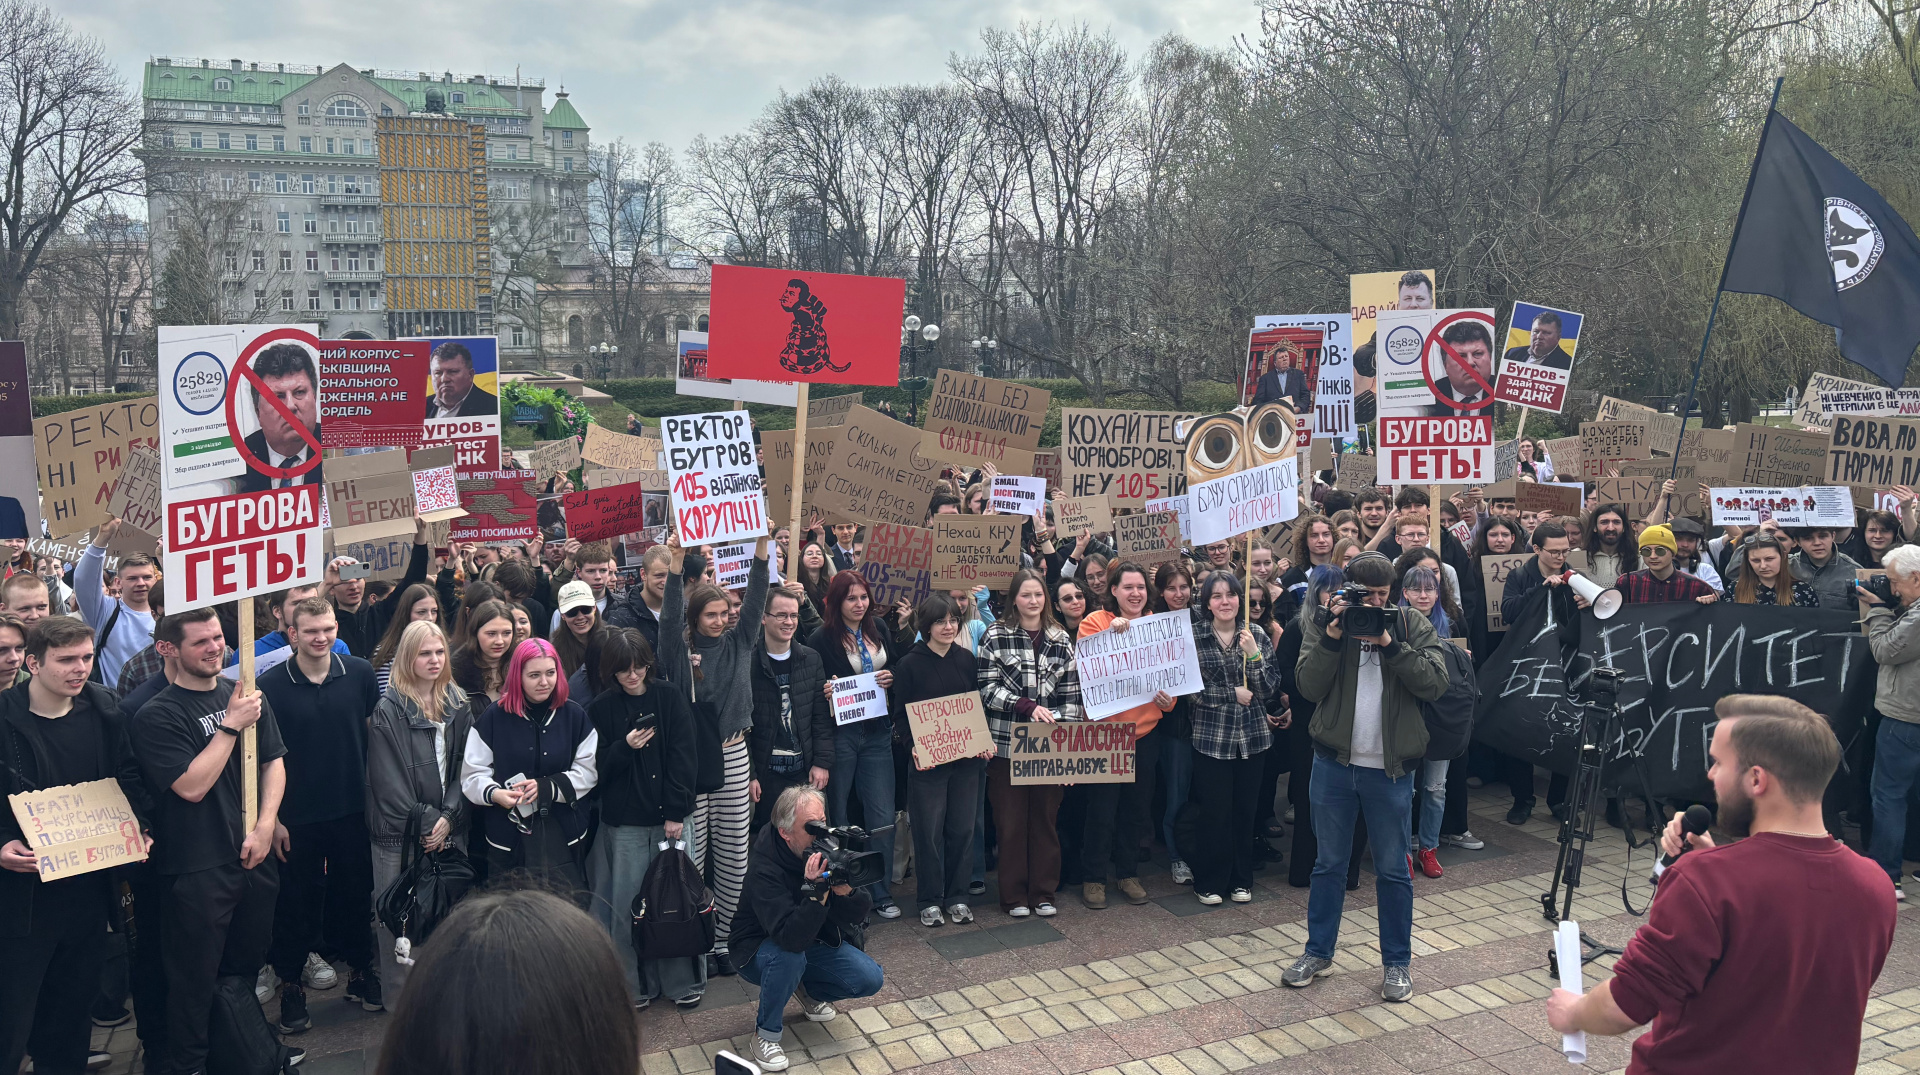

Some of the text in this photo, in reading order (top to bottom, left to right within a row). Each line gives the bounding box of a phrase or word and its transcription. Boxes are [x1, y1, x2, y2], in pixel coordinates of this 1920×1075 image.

[1389, 337, 1420, 349] 25829
[349, 349, 401, 360] КОРПУС
[1506, 361, 1557, 380] Бугров
[179, 371, 223, 390] 25829
[1507, 377, 1558, 393] здай тест
[379, 391, 389, 401] А
[390, 391, 409, 401] НЕ
[939, 373, 1029, 410] ВЛАДА БЕЗ
[1505, 387, 1554, 404] на ДНК
[1820, 393, 1831, 403] НІ
[1885, 390, 1896, 400] НІ
[1821, 403, 1833, 413] НЕ
[1833, 402, 1876, 412] ТЕРПІЛИ
[1886, 400, 1900, 409] ЦЕ
[423, 421, 484, 439] угров
[666, 414, 744, 443] РЕКТОР
[1386, 418, 1487, 444] БУГРОВА
[1833, 417, 1894, 453] ВОВА,
[455, 439, 488, 450] тест
[847, 425, 898, 460] СКІЛЬКИ
[939, 426, 1007, 461] СВАВІЛЛЯ
[1582, 435, 1644, 448] ЧОРНОБРИВІ
[1749, 432, 1767, 450] НІ
[453, 450, 487, 468] НК
[1582, 447, 1595, 458] ТА
[1600, 447, 1612, 457] НЕ
[1745, 452, 1763, 467] НІ
[519, 469, 536, 478] ТЕЖ
[1391, 448, 1482, 480] ГЕТЬ!
[1829, 450, 1894, 486] ТЮРМА
[48, 461, 76, 488] НІ
[994, 478, 1019, 487] SMALL
[673, 471, 708, 502] 105
[825, 473, 915, 515] СТІЛЬКИ РОКІВ
[993, 489, 1036, 500] DICKTATOR
[1073, 473, 1096, 497] НЕ
[1095, 473, 1114, 495] У
[1198, 480, 1225, 513] БАЧУ
[1228, 469, 1270, 505] СПРАВИ
[1597, 479, 1654, 501] КНУ
[54, 497, 77, 521] НІ
[848, 499, 866, 515] ЗА
[993, 500, 1021, 511] ENERGY
[1059, 501, 1082, 517] КНУ
[1228, 492, 1281, 532] РЕКТОРЕ!
[177, 489, 314, 546] БУГРОВА
[678, 493, 761, 542] КОРУПЦІЇ
[1120, 512, 1169, 529] UTILITAS
[481, 527, 534, 538] ПОСИПАЛАСЬ
[938, 522, 1016, 540] Нехай КНУ
[1121, 527, 1158, 542] HONOR
[717, 546, 745, 559] SMALL
[1131, 538, 1166, 552] GLORIA
[184, 532, 307, 603] ГЕТЬ!
[941, 565, 957, 579] НЕ
[958, 564, 978, 580] 105
[1080, 649, 1140, 683] А ВИ ТУДИ
[834, 679, 858, 694] SMALL
[1082, 683, 1109, 709] ХТОСЬ
[836, 689, 877, 708] DICKTATOR
[839, 706, 866, 722] ENERGY
[911, 695, 974, 724] ЧЕРВОНІЮ
[934, 718, 952, 733] ЗА
[917, 726, 973, 750] ЧЕРВОНИЙ
[1051, 722, 1136, 752] ФІЛОСОФІЯ
[929, 740, 967, 764] КОРПУС!
[1012, 752, 1136, 778] ВИПРАВДОВУЄ ЦЕ?
[37, 819, 143, 856] ПОВИНЕН Я
[39, 855, 56, 874] А
[55, 850, 81, 871] НЕ
